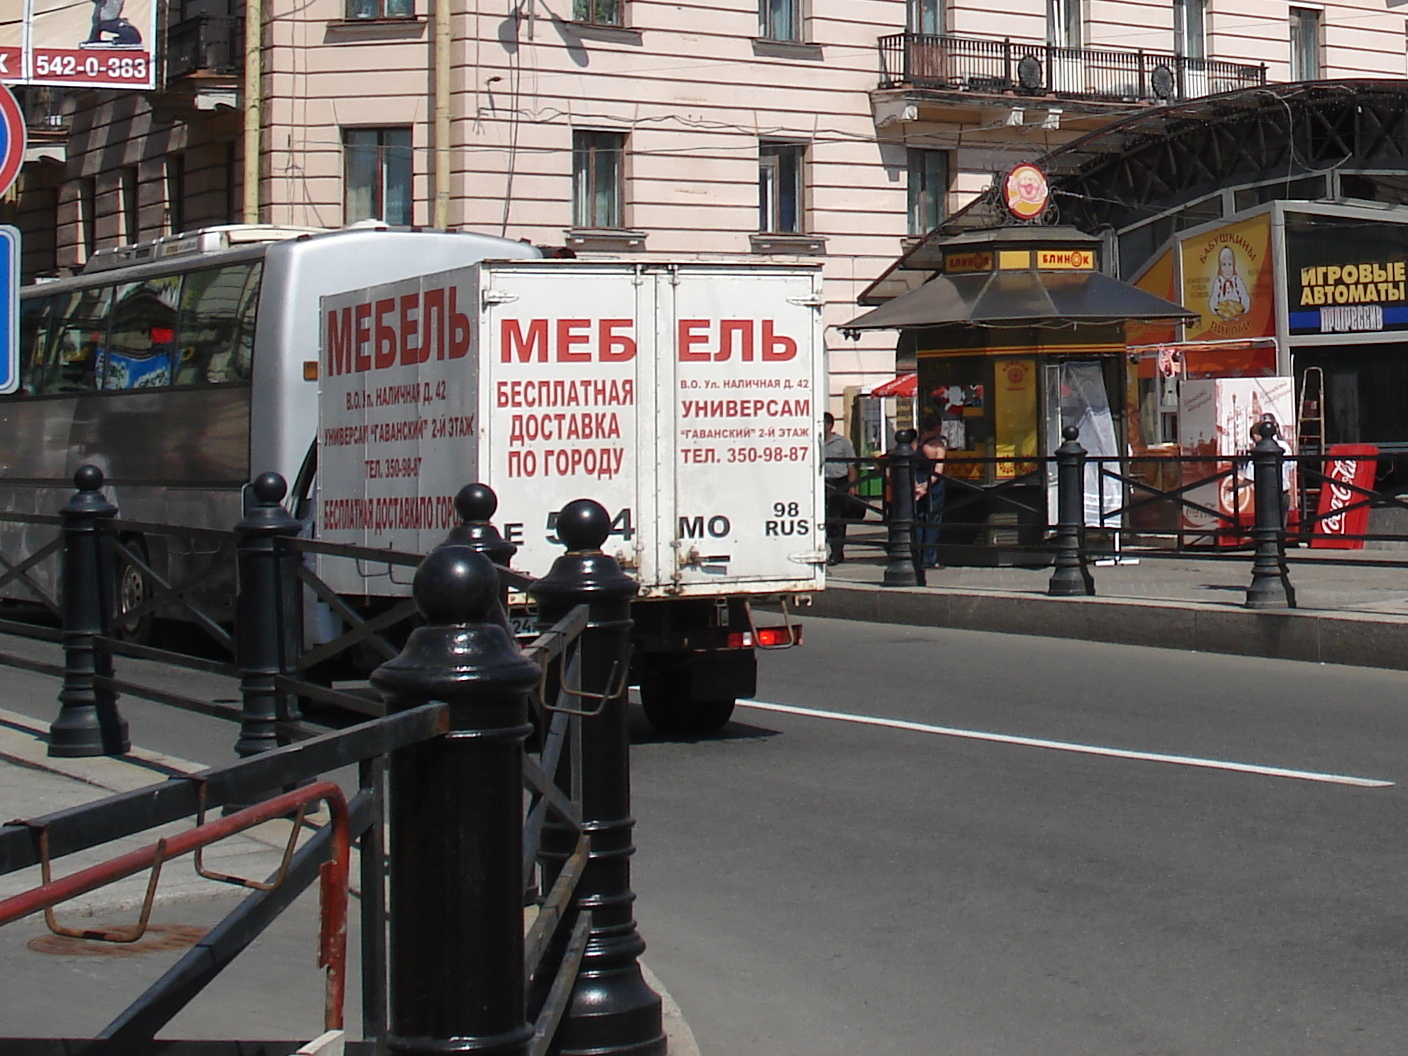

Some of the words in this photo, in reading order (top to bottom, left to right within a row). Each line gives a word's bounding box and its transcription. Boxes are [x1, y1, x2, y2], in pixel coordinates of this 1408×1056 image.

[36, 55, 146, 78] 542-0-383
[1042, 250, 1090, 268] БЛИНОК
[1199, 232, 1257, 264] БАБУШКИНЫ
[1301, 262, 1406, 286] ИГРОВЫЕ
[1300, 282, 1406, 305] АВТОМАТЫ
[1210, 320, 1251, 336] ПИРОГИ
[1319, 305, 1384, 332] ПРОГРЕССИВ
[328, 286, 471, 377] МЕБЕЛЬ
[376, 382, 420, 407] НАЛИЧНАЯ
[423, 381, 433, 406] Д.
[435, 380, 446, 401] 42
[497, 379, 634, 408] БЕСПЛАТНАЯ
[681, 380, 701, 389] В.О.
[704, 379, 720, 389] Ул.
[723, 379, 780, 389] НАЛИЧНАЯ
[783, 379, 794, 390] Д.
[797, 379, 809, 389] 42
[681, 400, 810, 418] УНИВЕРСАМ
[431, 414, 446, 438] 2-Й
[448, 413, 474, 438] ЭТАЖ
[509, 412, 621, 447] ДОСТАВКА
[758, 427, 775, 438] 2-Й
[778, 428, 809, 438] ЭТАЖ
[508, 450, 537, 477] ПО
[544, 447, 624, 480] ГОРОДУ
[681, 449, 721, 464] ТЕЛ.
[727, 447, 809, 463] 350-98-87
[365, 459, 383, 479] ТЕЛ.
[385, 457, 422, 478] 350-98-87
[324, 498, 374, 530] БЕСПЛАТНАЯ
[773, 502, 799, 518] 98
[503, 523, 525, 546] Е
[679, 515, 731, 539] МО
[765, 519, 809, 536] RUS
